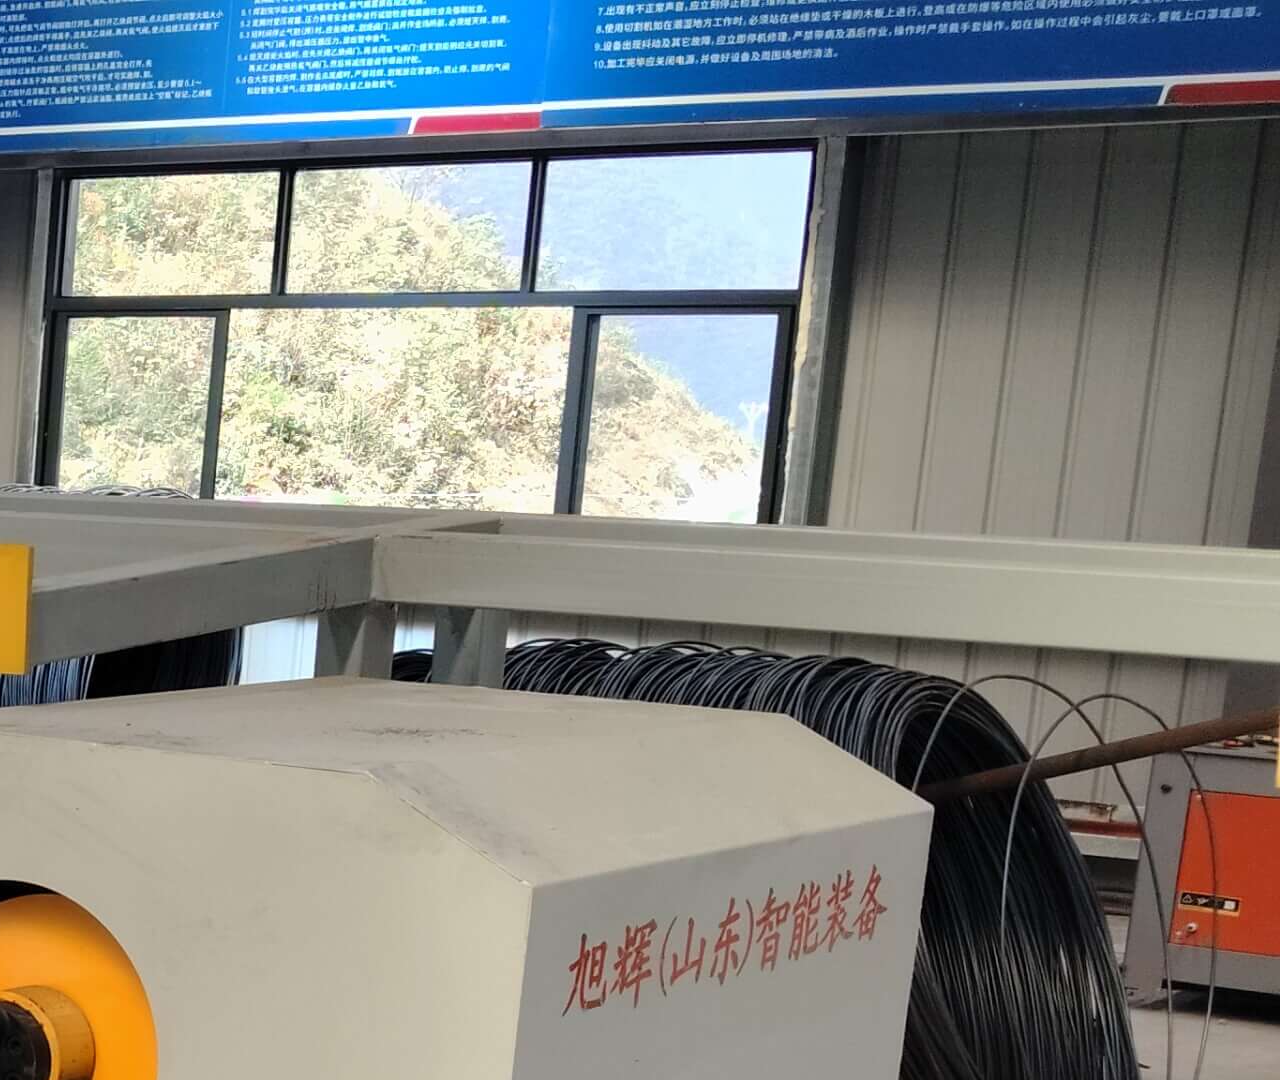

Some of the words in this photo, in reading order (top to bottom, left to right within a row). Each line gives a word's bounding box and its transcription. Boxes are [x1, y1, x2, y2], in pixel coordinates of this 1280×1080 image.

[562, 863, 888, 1017] 旭辉(山东)智能装备
